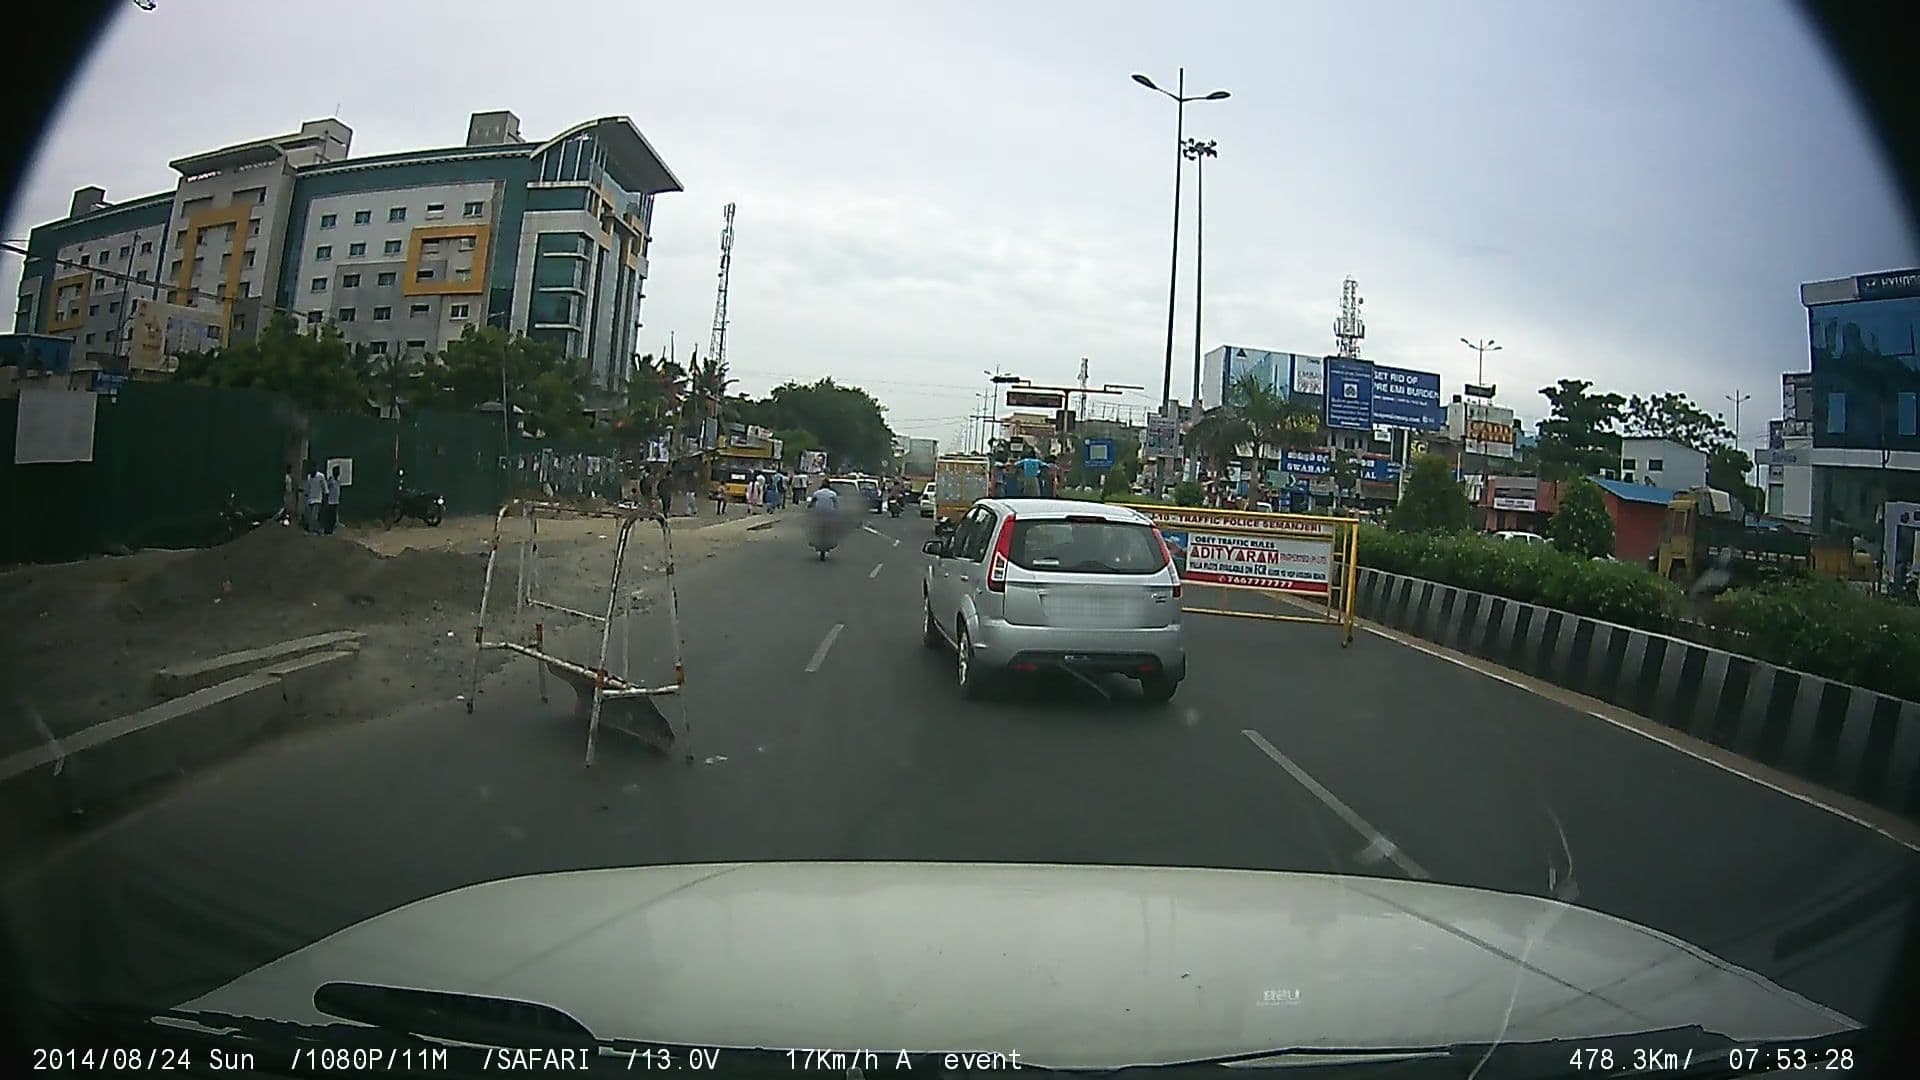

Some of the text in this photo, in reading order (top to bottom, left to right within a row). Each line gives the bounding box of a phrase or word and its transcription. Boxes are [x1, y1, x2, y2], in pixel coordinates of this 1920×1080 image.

[1390, 373, 1405, 382] RID
[1178, 514, 1220, 526] TRAFFIC
[1223, 518, 1259, 529] POLICE
[1195, 536, 1275, 549] OBEY TRAFFIC RULES
[1190, 544, 1279, 564] ADITYARAM
